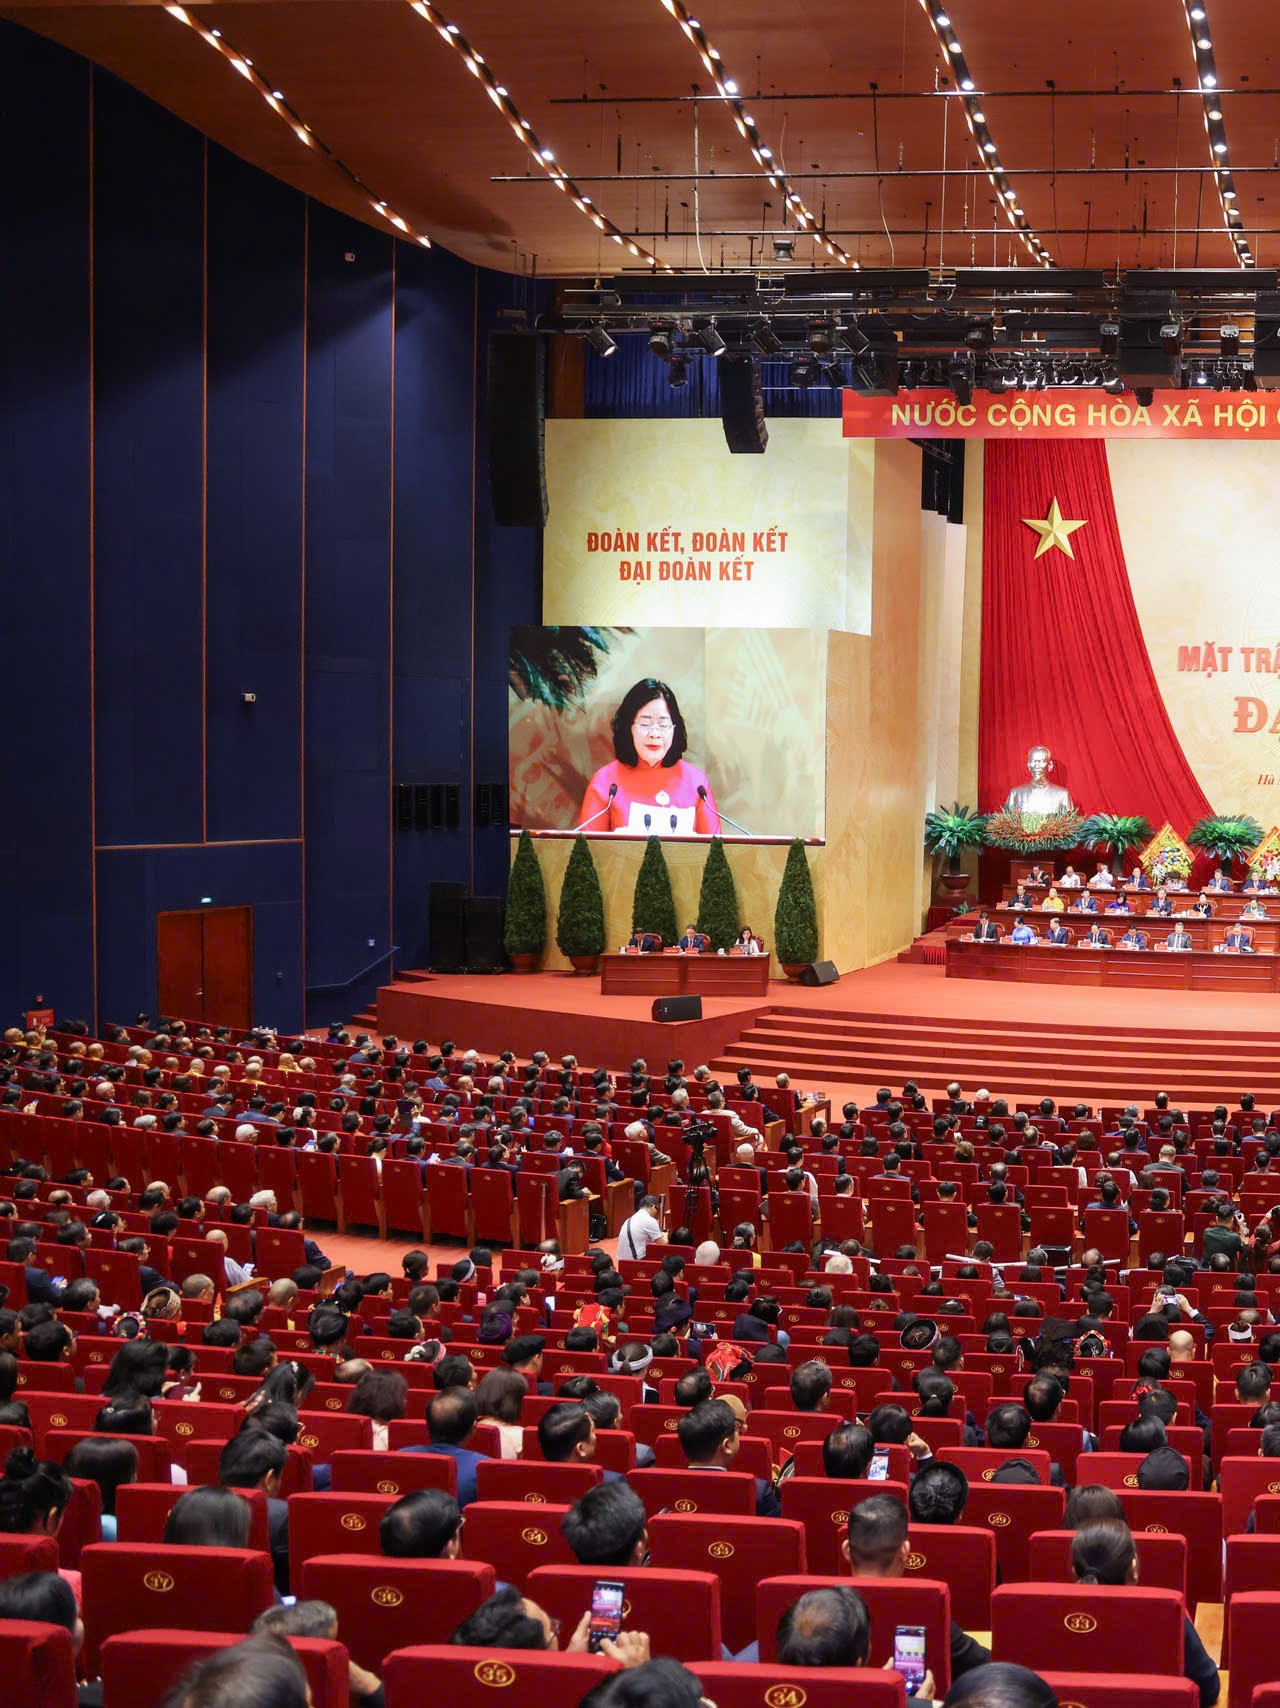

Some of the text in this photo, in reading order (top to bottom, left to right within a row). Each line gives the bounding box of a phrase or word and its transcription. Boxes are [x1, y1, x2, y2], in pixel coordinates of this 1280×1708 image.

[891, 399, 976, 426] NƯỚC
[987, 398, 1076, 431] CỘNG
[1088, 399, 1152, 427] HÒA
[1162, 399, 1203, 427] XÃ
[1214, 398, 1265, 432] HỘI
[587, 525, 789, 555] ĐOÀN KẾT, ĐOÀN KẾT
[619, 554, 755, 585] ĐẠI ĐOÀN KẾT
[1177, 641, 1232, 678] MẶT
[1257, 774, 1274, 785] Hà
[787, 1428, 797, 1436] 31
[304, 1437, 315, 1445] 34
[680, 1502, 692, 1511] 31
[346, 1516, 360, 1527] 35
[835, 1513, 849, 1523] 30
[994, 1516, 1007, 1524] 29
[528, 1531, 542, 1542] 34
[714, 1545, 729, 1555] 33
[150, 1576, 169, 1588] 37
[378, 1591, 397, 1603] 36
[1070, 1616, 1090, 1629] 33
[483, 1666, 507, 1682] 35
[774, 1690, 798, 1705] 34
